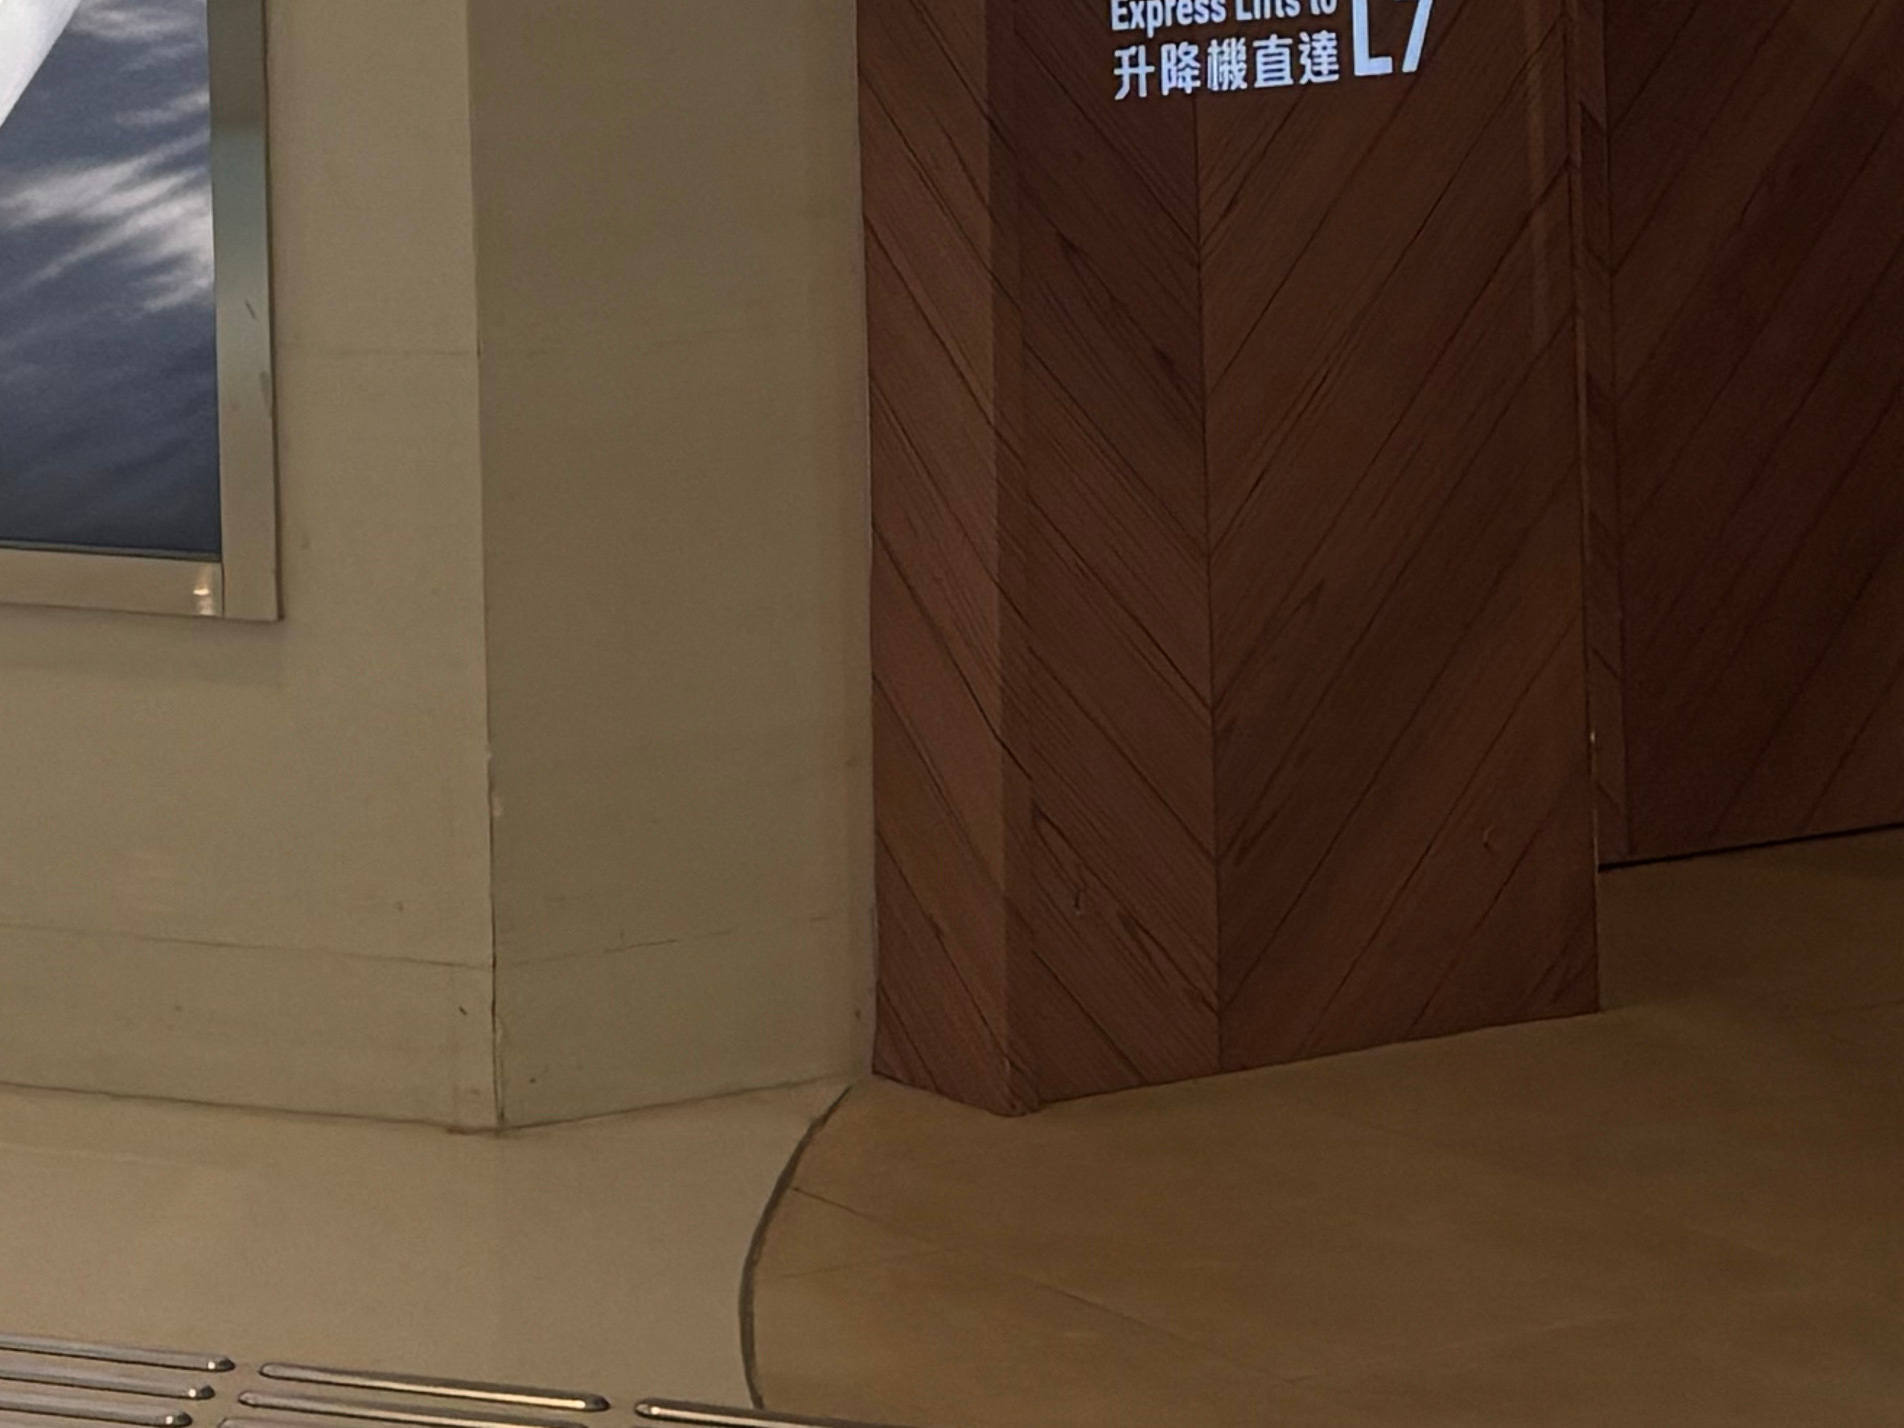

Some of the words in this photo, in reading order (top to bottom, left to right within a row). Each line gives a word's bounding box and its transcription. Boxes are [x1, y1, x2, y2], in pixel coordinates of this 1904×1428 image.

[1113, 30, 1340, 101] 升降機直達
